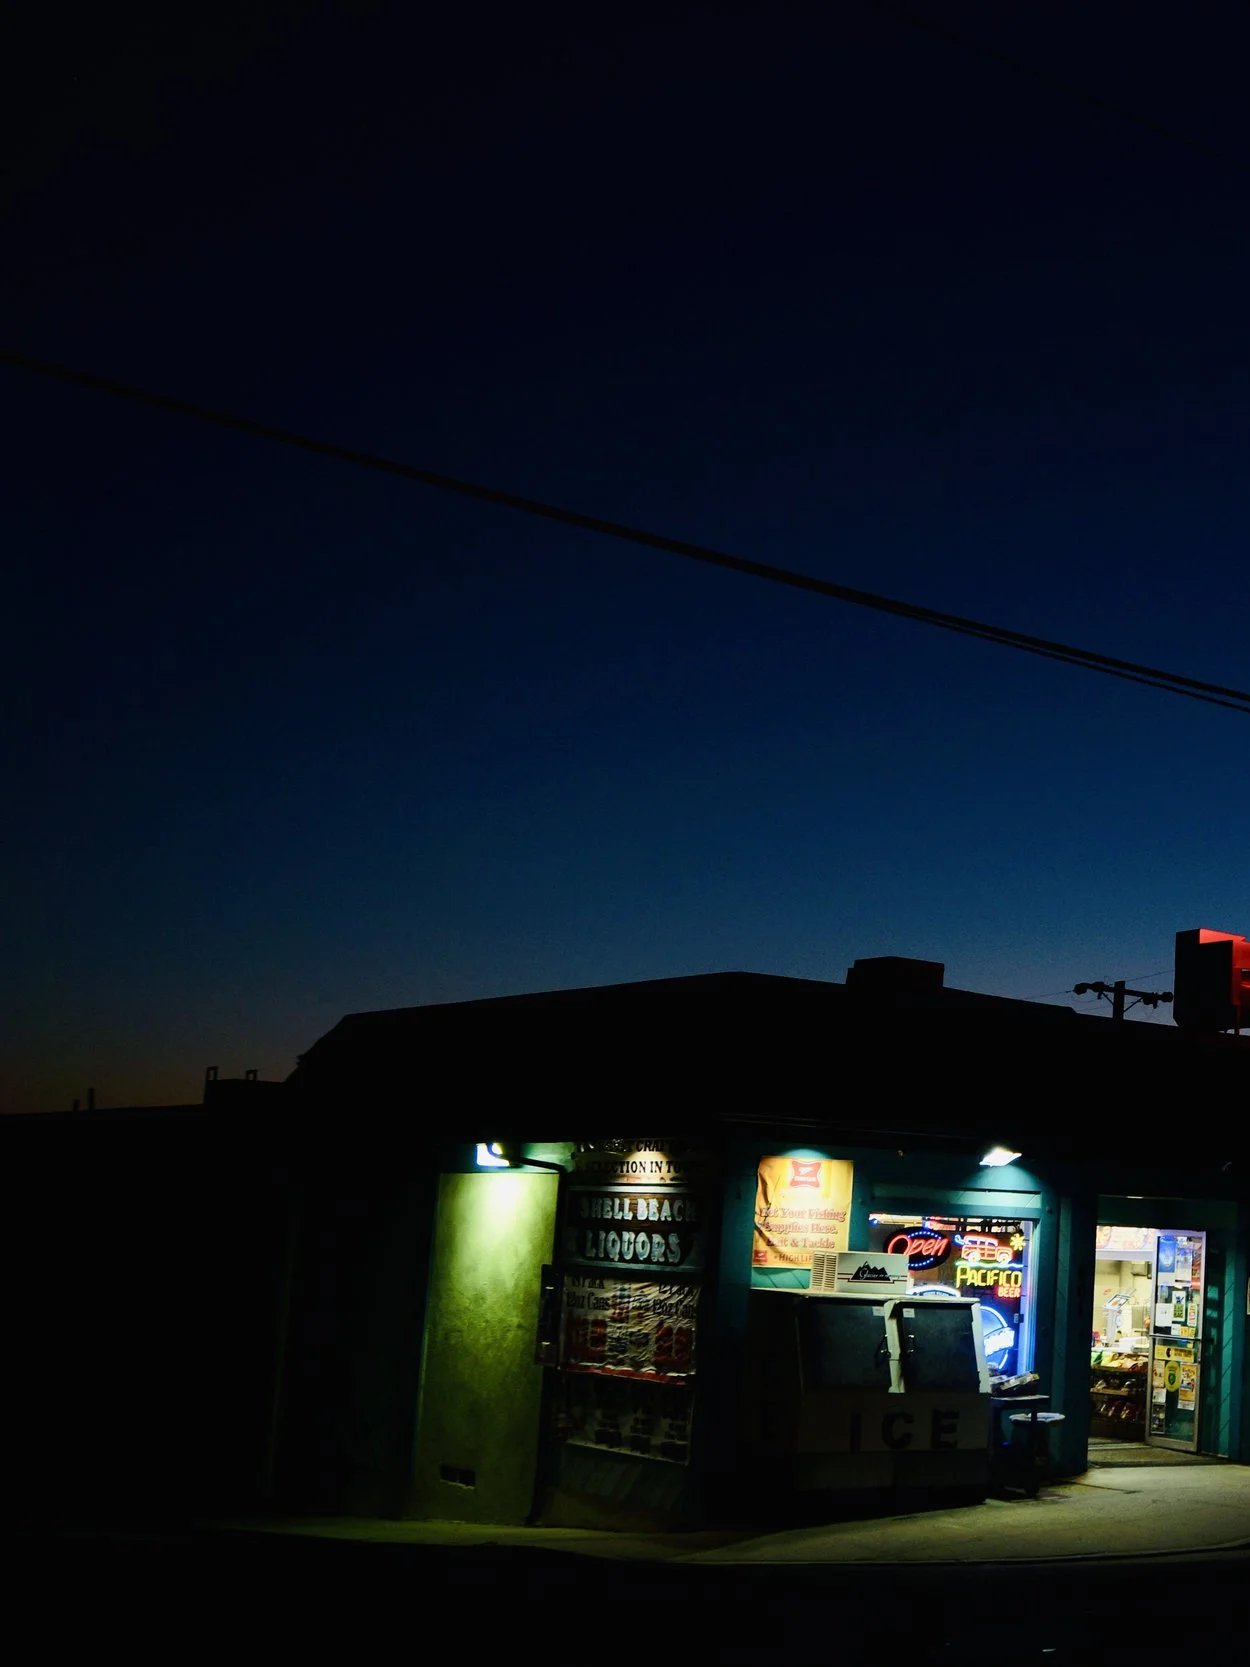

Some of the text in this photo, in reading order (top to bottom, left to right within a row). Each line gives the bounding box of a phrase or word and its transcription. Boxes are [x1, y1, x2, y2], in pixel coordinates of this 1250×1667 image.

[650, 1160, 663, 1174] IN
[580, 1196, 697, 1222] SHELL BEACH
[585, 1229, 682, 1264] LIQUORS
[887, 1234, 951, 1257] Open
[956, 1264, 1023, 1289] PACIFICO
[997, 1286, 1021, 1298] BEER
[850, 1408, 960, 1450] ICE
